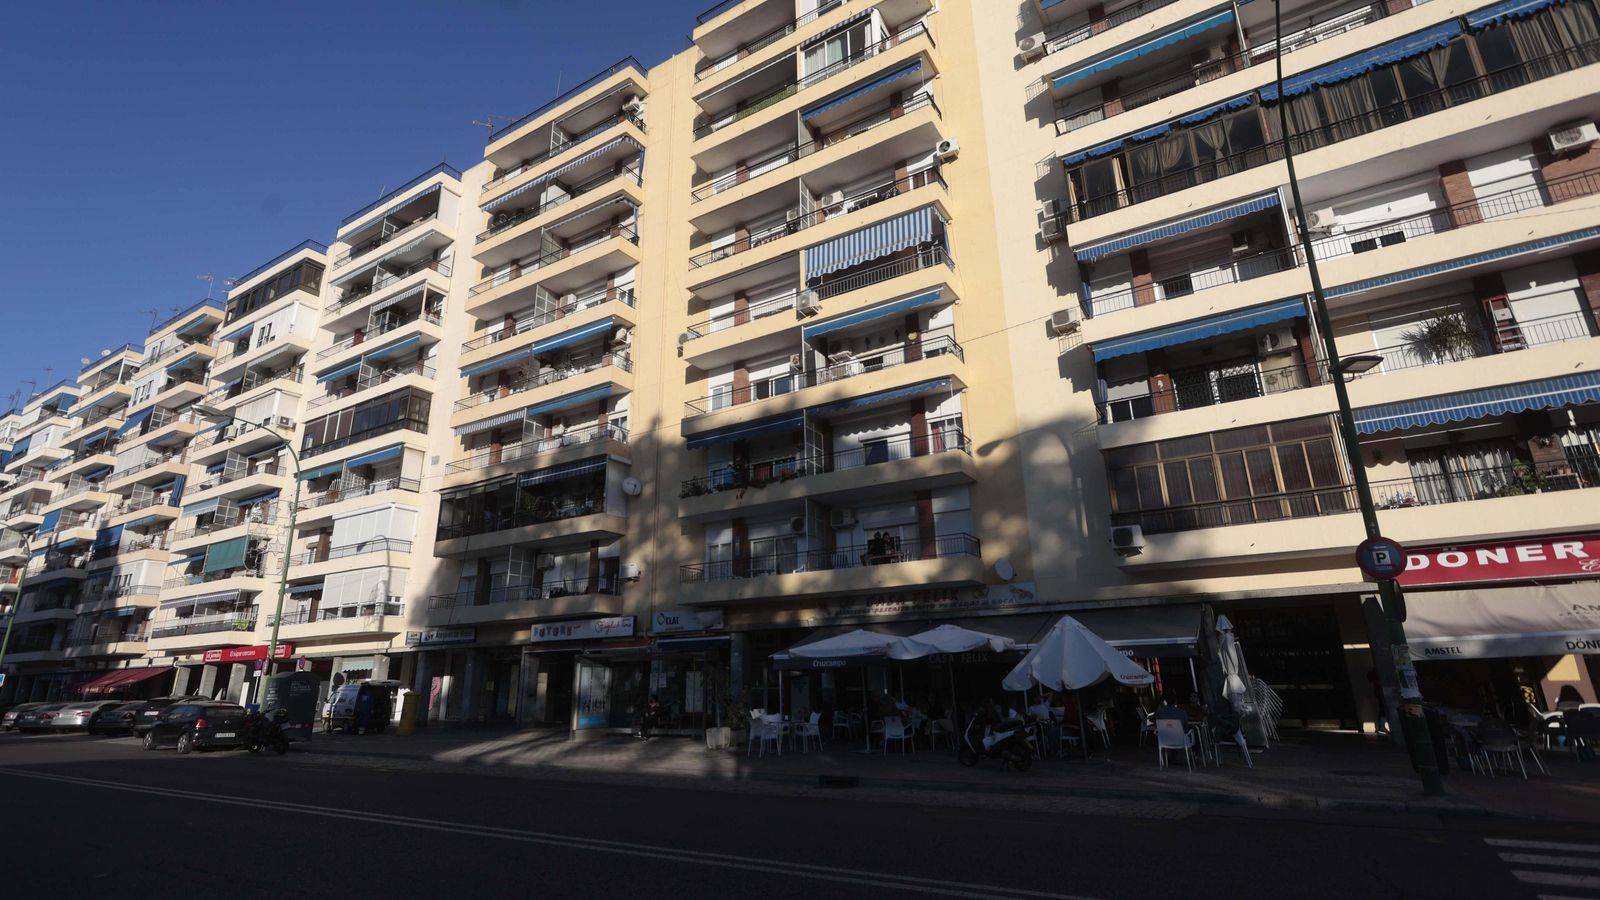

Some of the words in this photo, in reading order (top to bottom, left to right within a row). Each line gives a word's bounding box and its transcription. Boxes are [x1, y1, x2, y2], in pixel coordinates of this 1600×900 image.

[1376, 553, 1386, 563] P
[1405, 541, 1589, 571] DÖNER
[866, 593, 905, 607] CASA
[913, 588, 959, 603] FELIX
[1425, 646, 1462, 655] AMSTEL
[812, 659, 847, 668] Cruzcampo
[929, 653, 954, 664] CASA
[961, 652, 989, 663] FELIX
